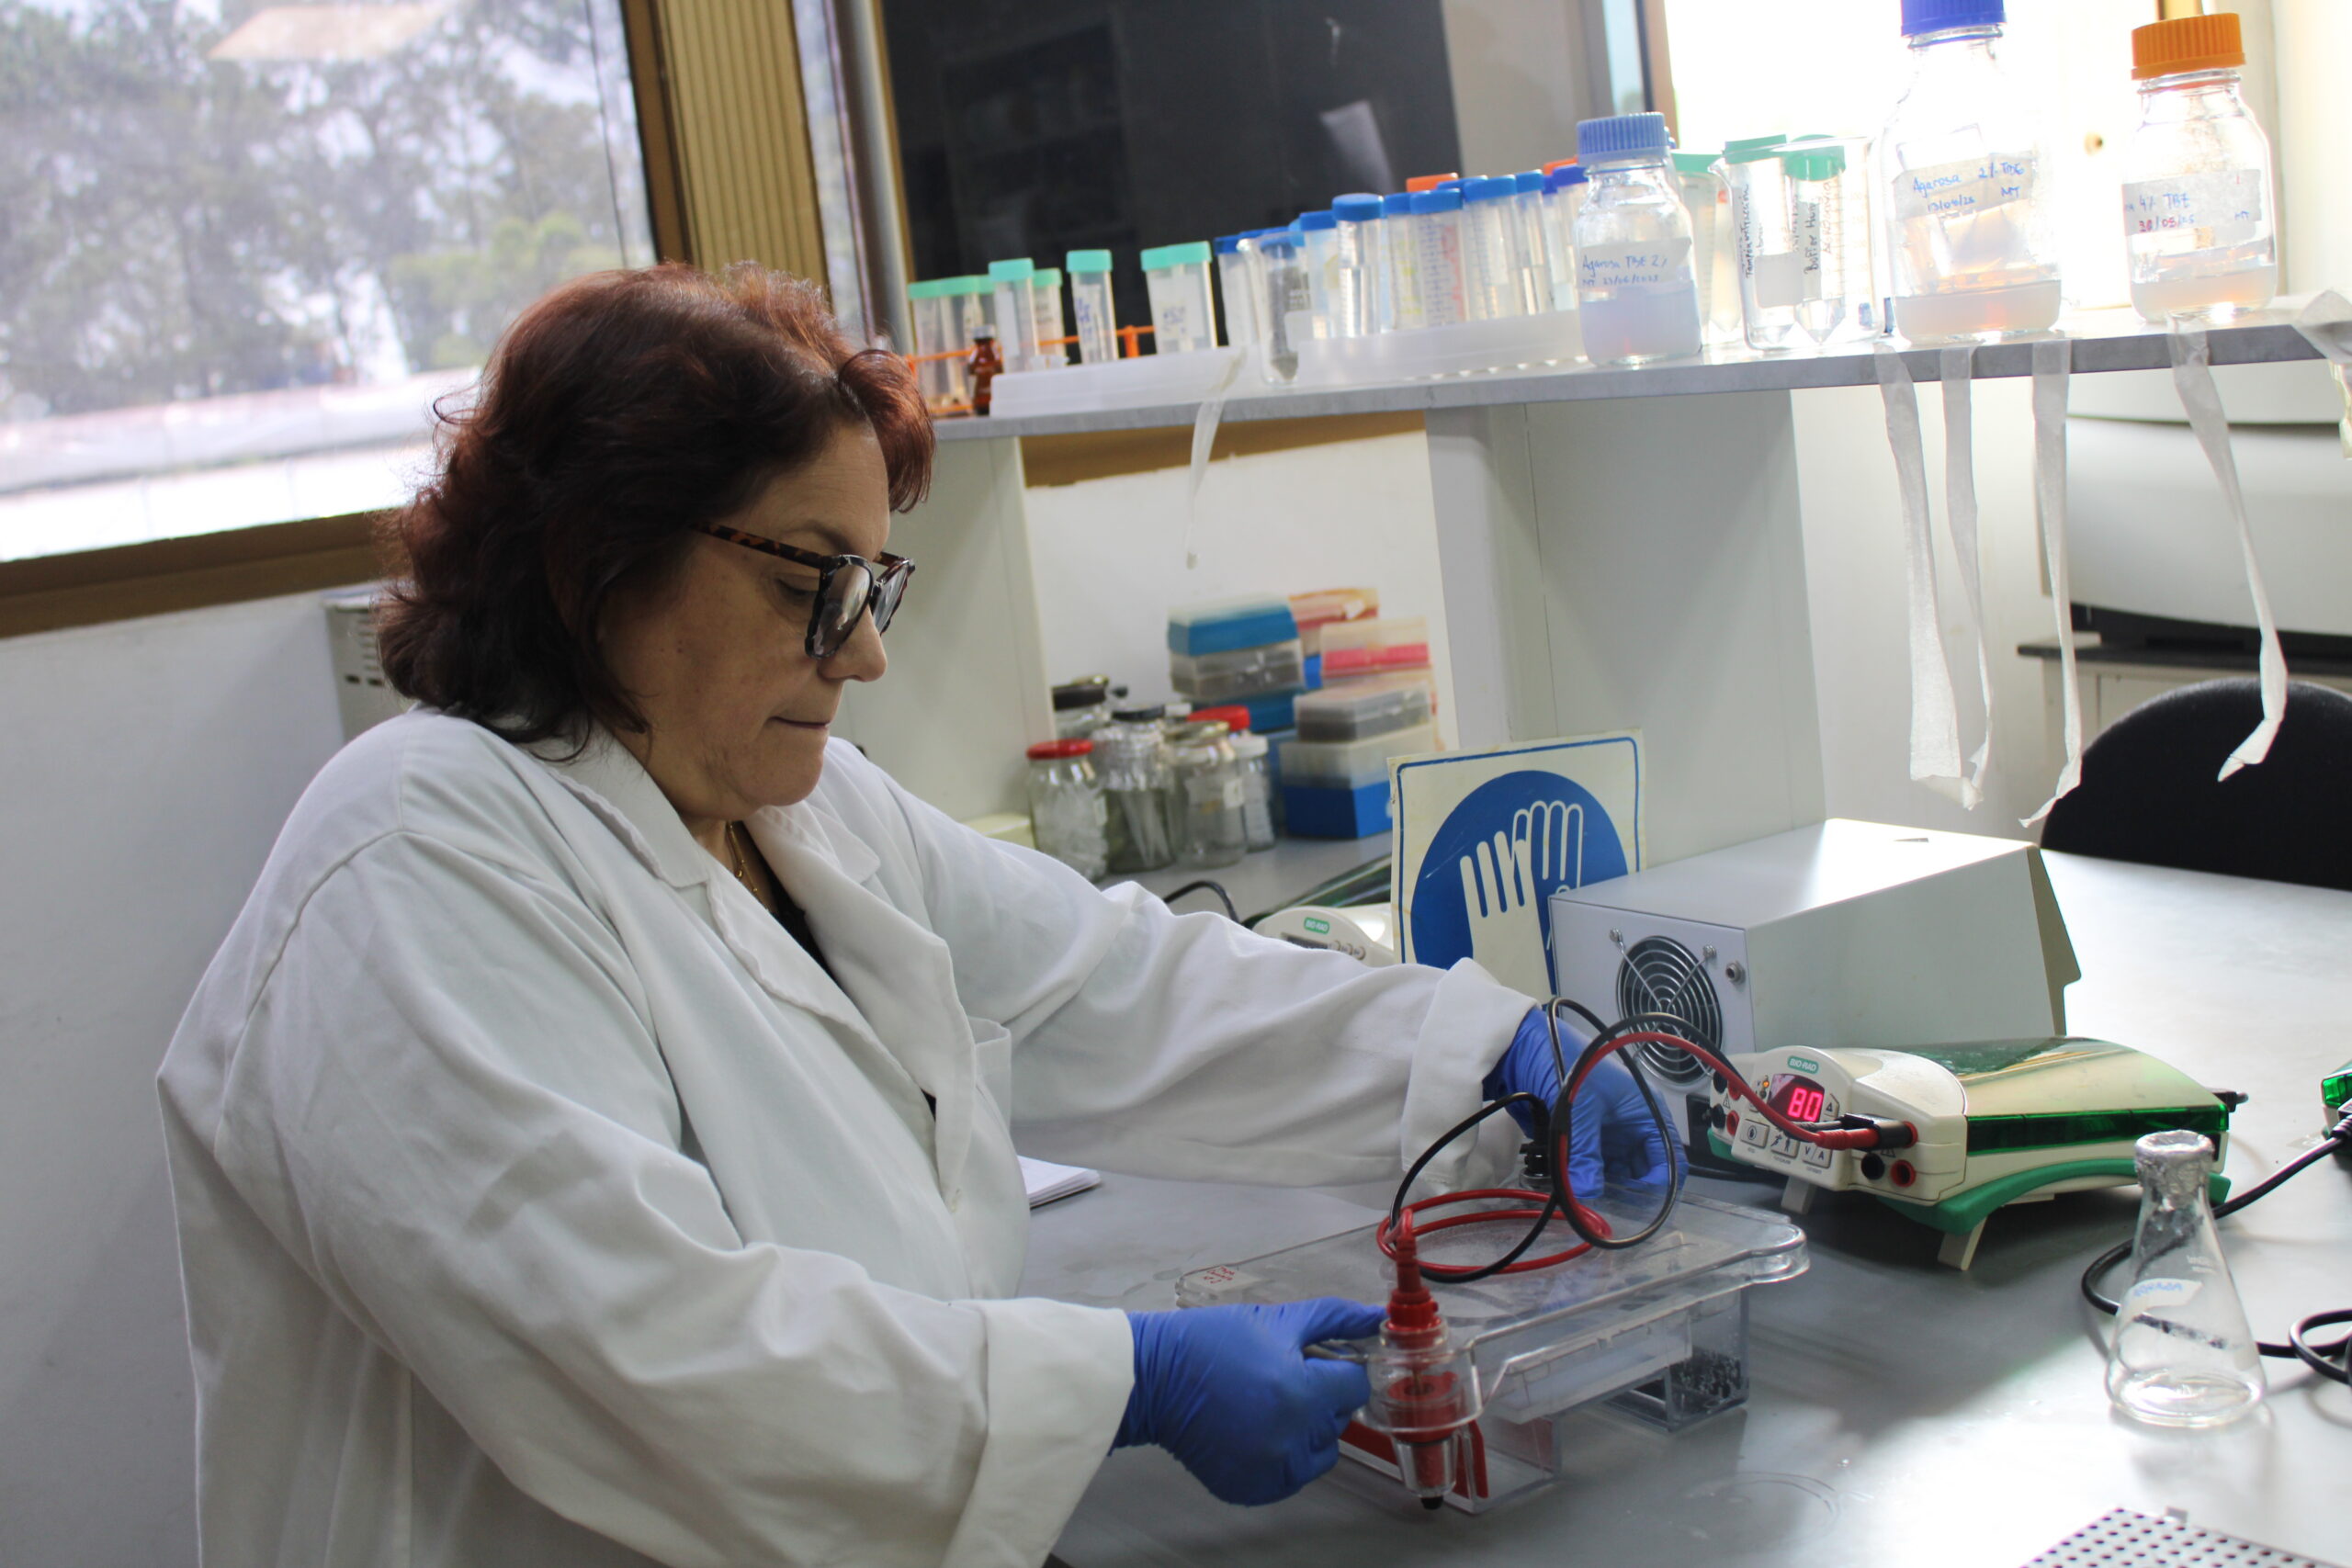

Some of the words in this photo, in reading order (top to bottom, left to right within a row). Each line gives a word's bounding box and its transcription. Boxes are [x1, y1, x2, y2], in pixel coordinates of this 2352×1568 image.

[1913, 174, 1962, 198] Agarosa
[1582, 254, 1622, 278] Agarosa
[1789, 1058, 1817, 1072] BIO-RAD
[1788, 1088, 1824, 1122] 80
